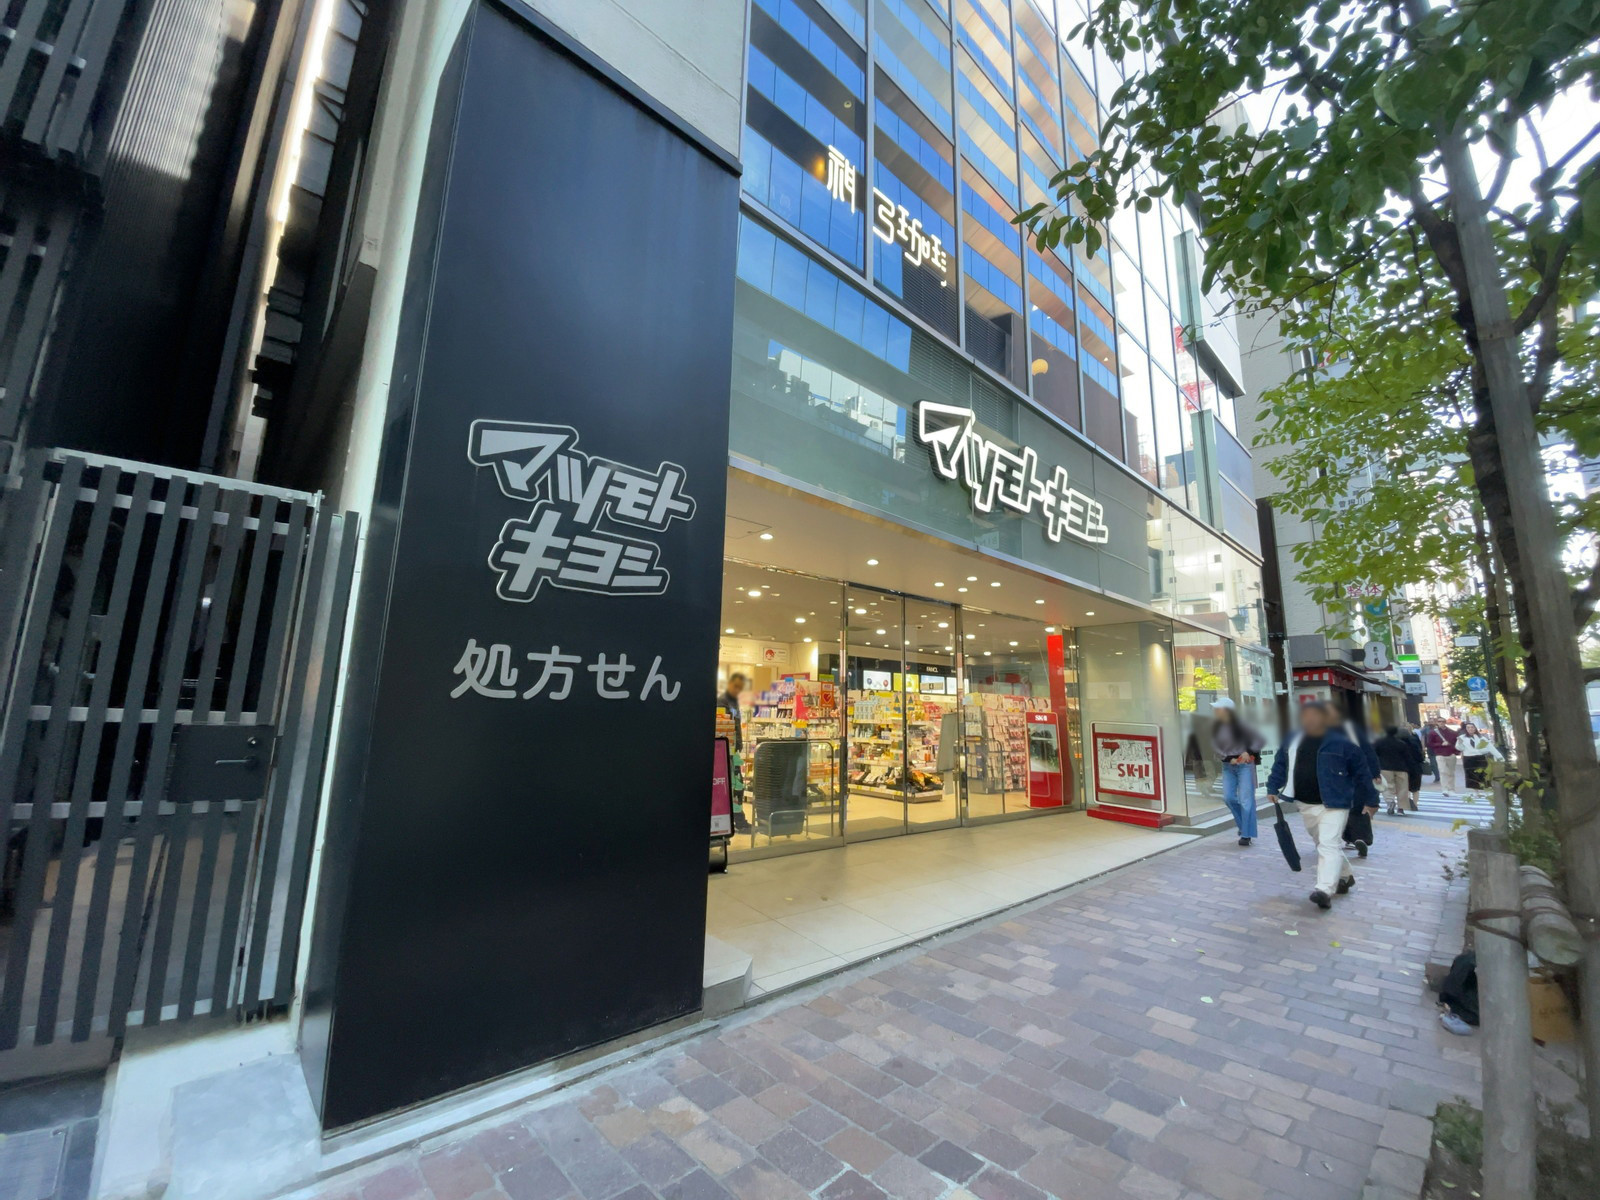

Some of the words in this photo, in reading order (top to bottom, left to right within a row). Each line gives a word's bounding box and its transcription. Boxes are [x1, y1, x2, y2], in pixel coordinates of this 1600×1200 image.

[472, 424, 694, 528] マツモト
[449, 637, 682, 702] 処方せん
